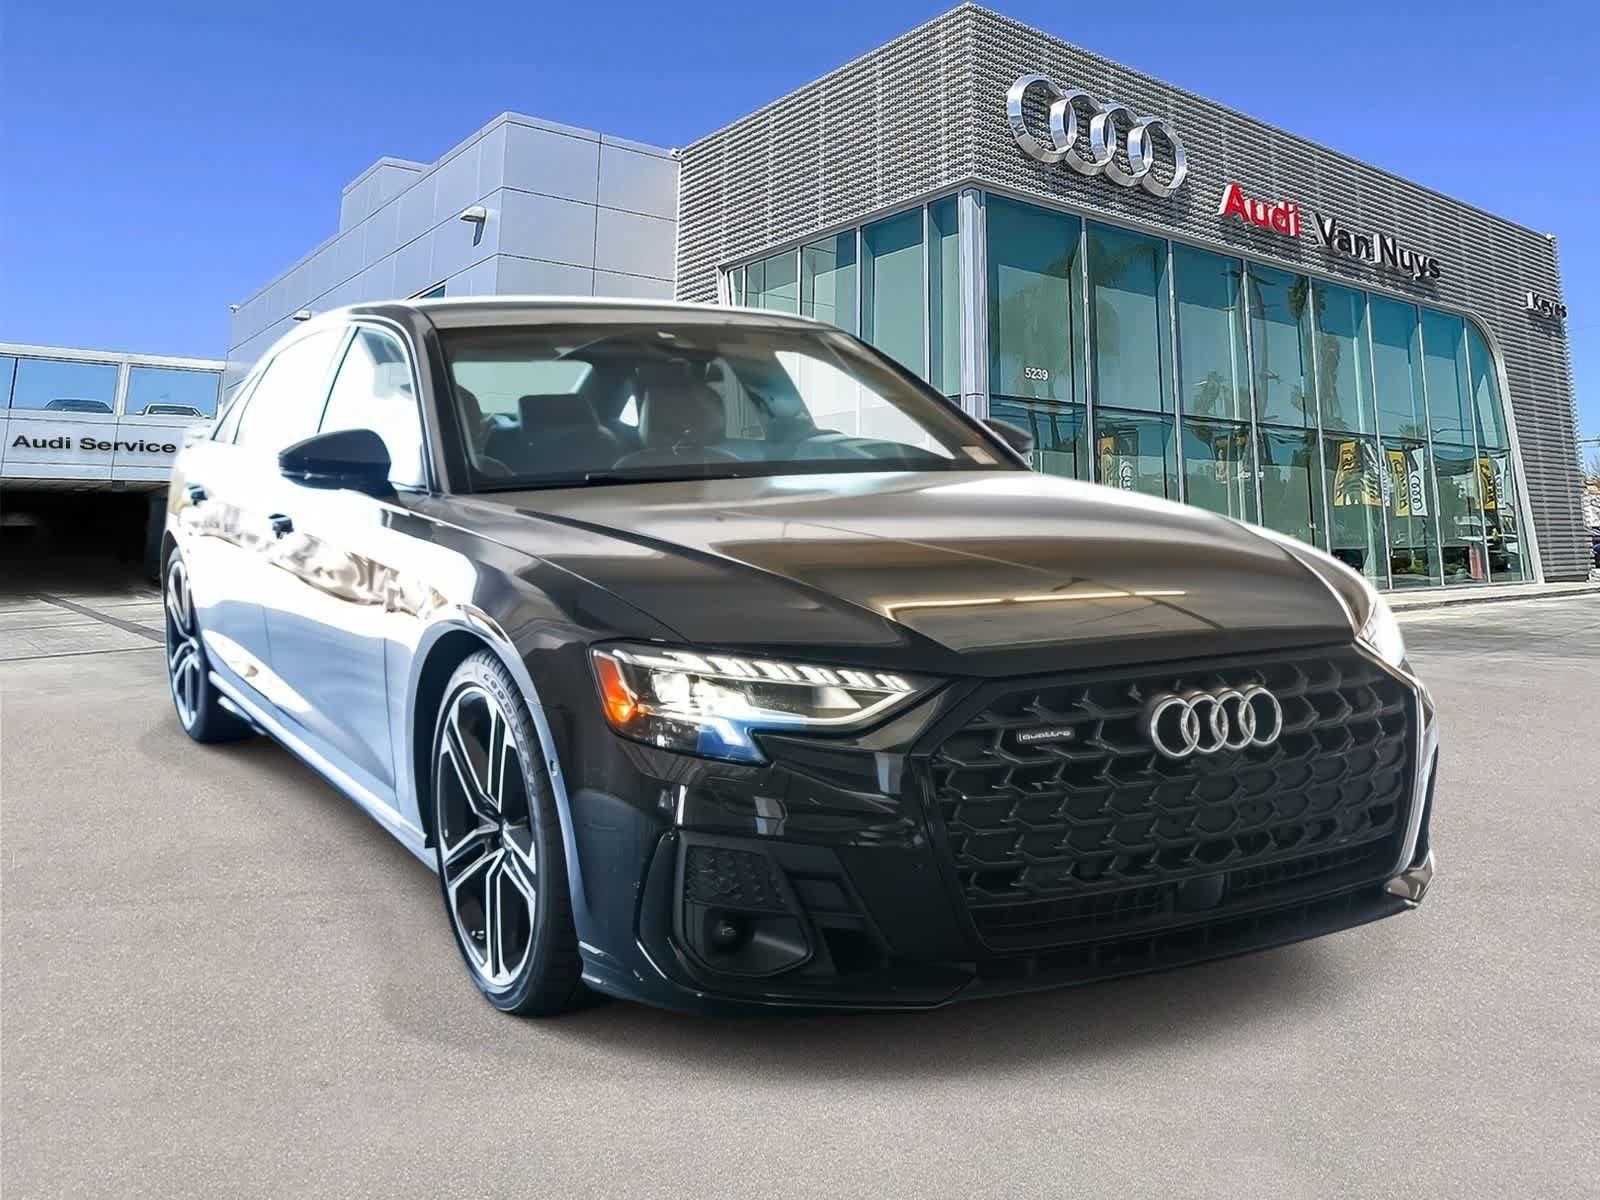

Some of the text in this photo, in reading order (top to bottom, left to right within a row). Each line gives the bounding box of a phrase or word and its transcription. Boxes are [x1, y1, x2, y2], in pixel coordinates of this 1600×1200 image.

[1218, 182, 1441, 281] Audi Van Nuys
[1024, 367, 1049, 381] 5239
[12, 434, 177, 454] Audi Service
